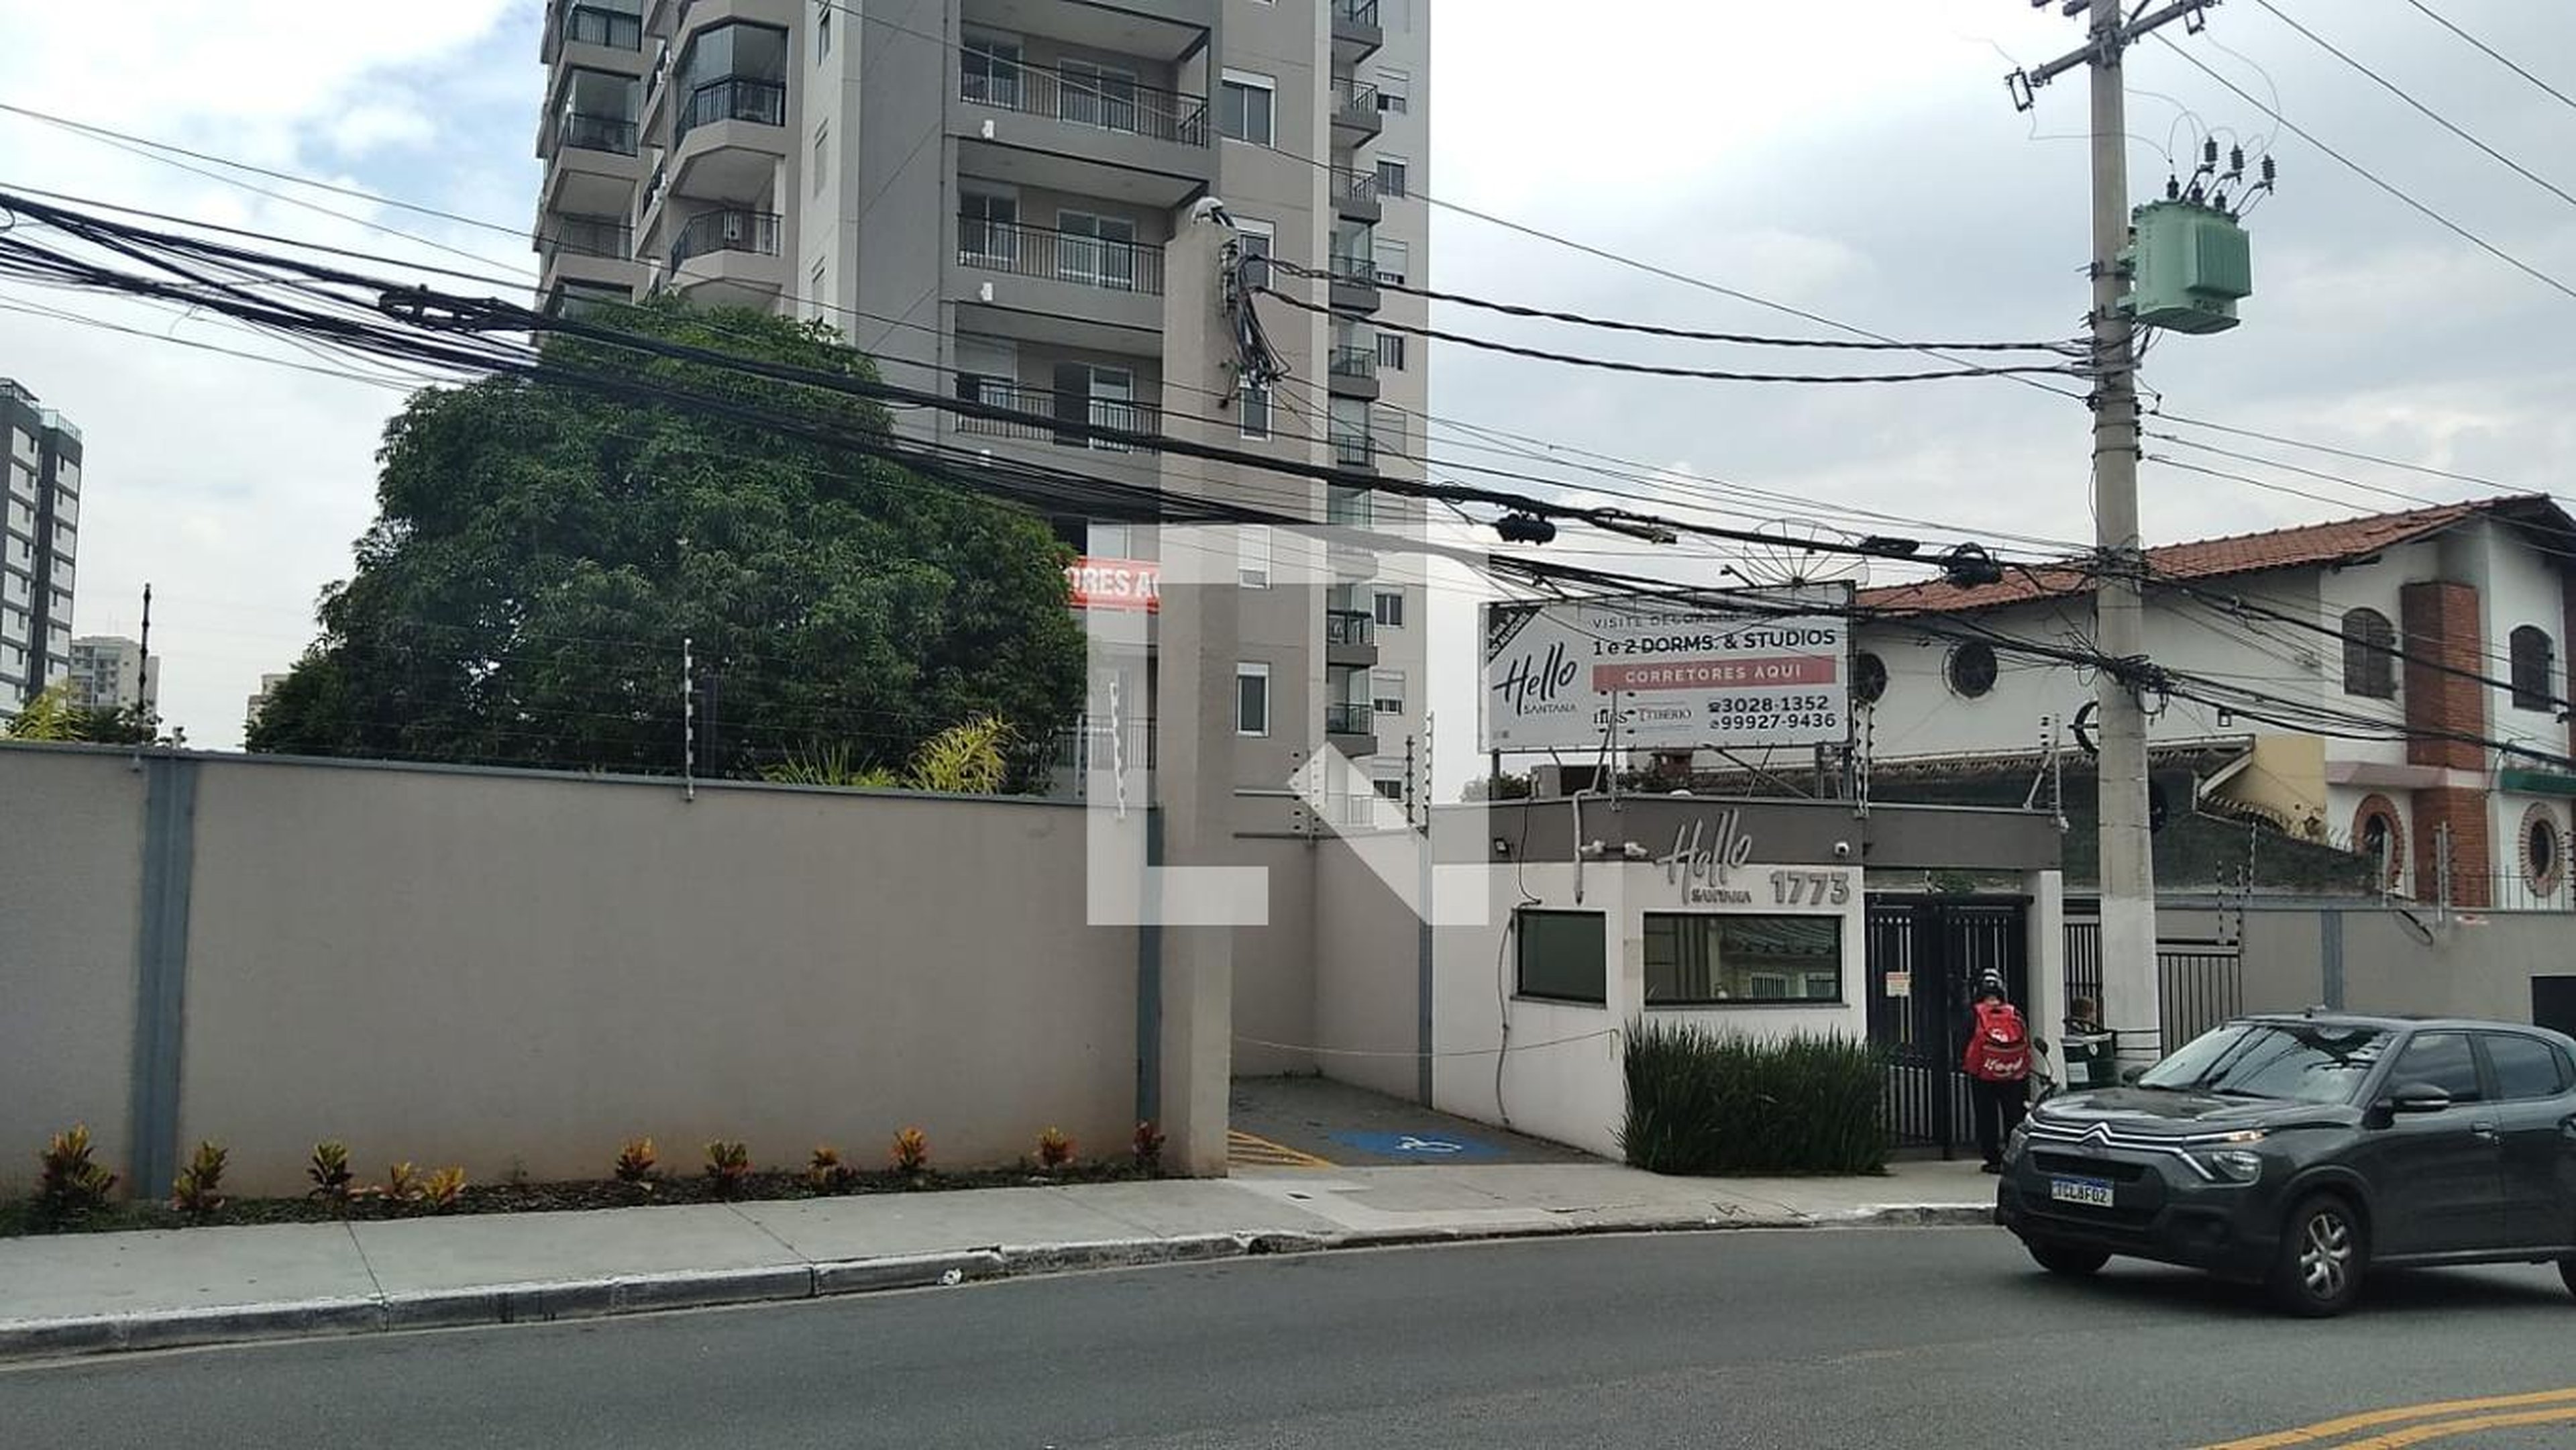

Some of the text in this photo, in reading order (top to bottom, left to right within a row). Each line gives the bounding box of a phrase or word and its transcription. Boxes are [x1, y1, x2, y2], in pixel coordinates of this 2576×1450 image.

[1593, 616, 1642, 629] VISITE
[1593, 629, 1836, 656] 1 e 2 DORMS. & STUDIOS
[1493, 641, 1578, 717] Hello
[1625, 664, 1801, 683] CORRETORES AQUI
[1721, 695, 1829, 713] 3028-1352
[1721, 713, 1836, 730] 99927-9436
[1656, 807, 1752, 906] Hello
[1769, 872, 1850, 905] 1773
